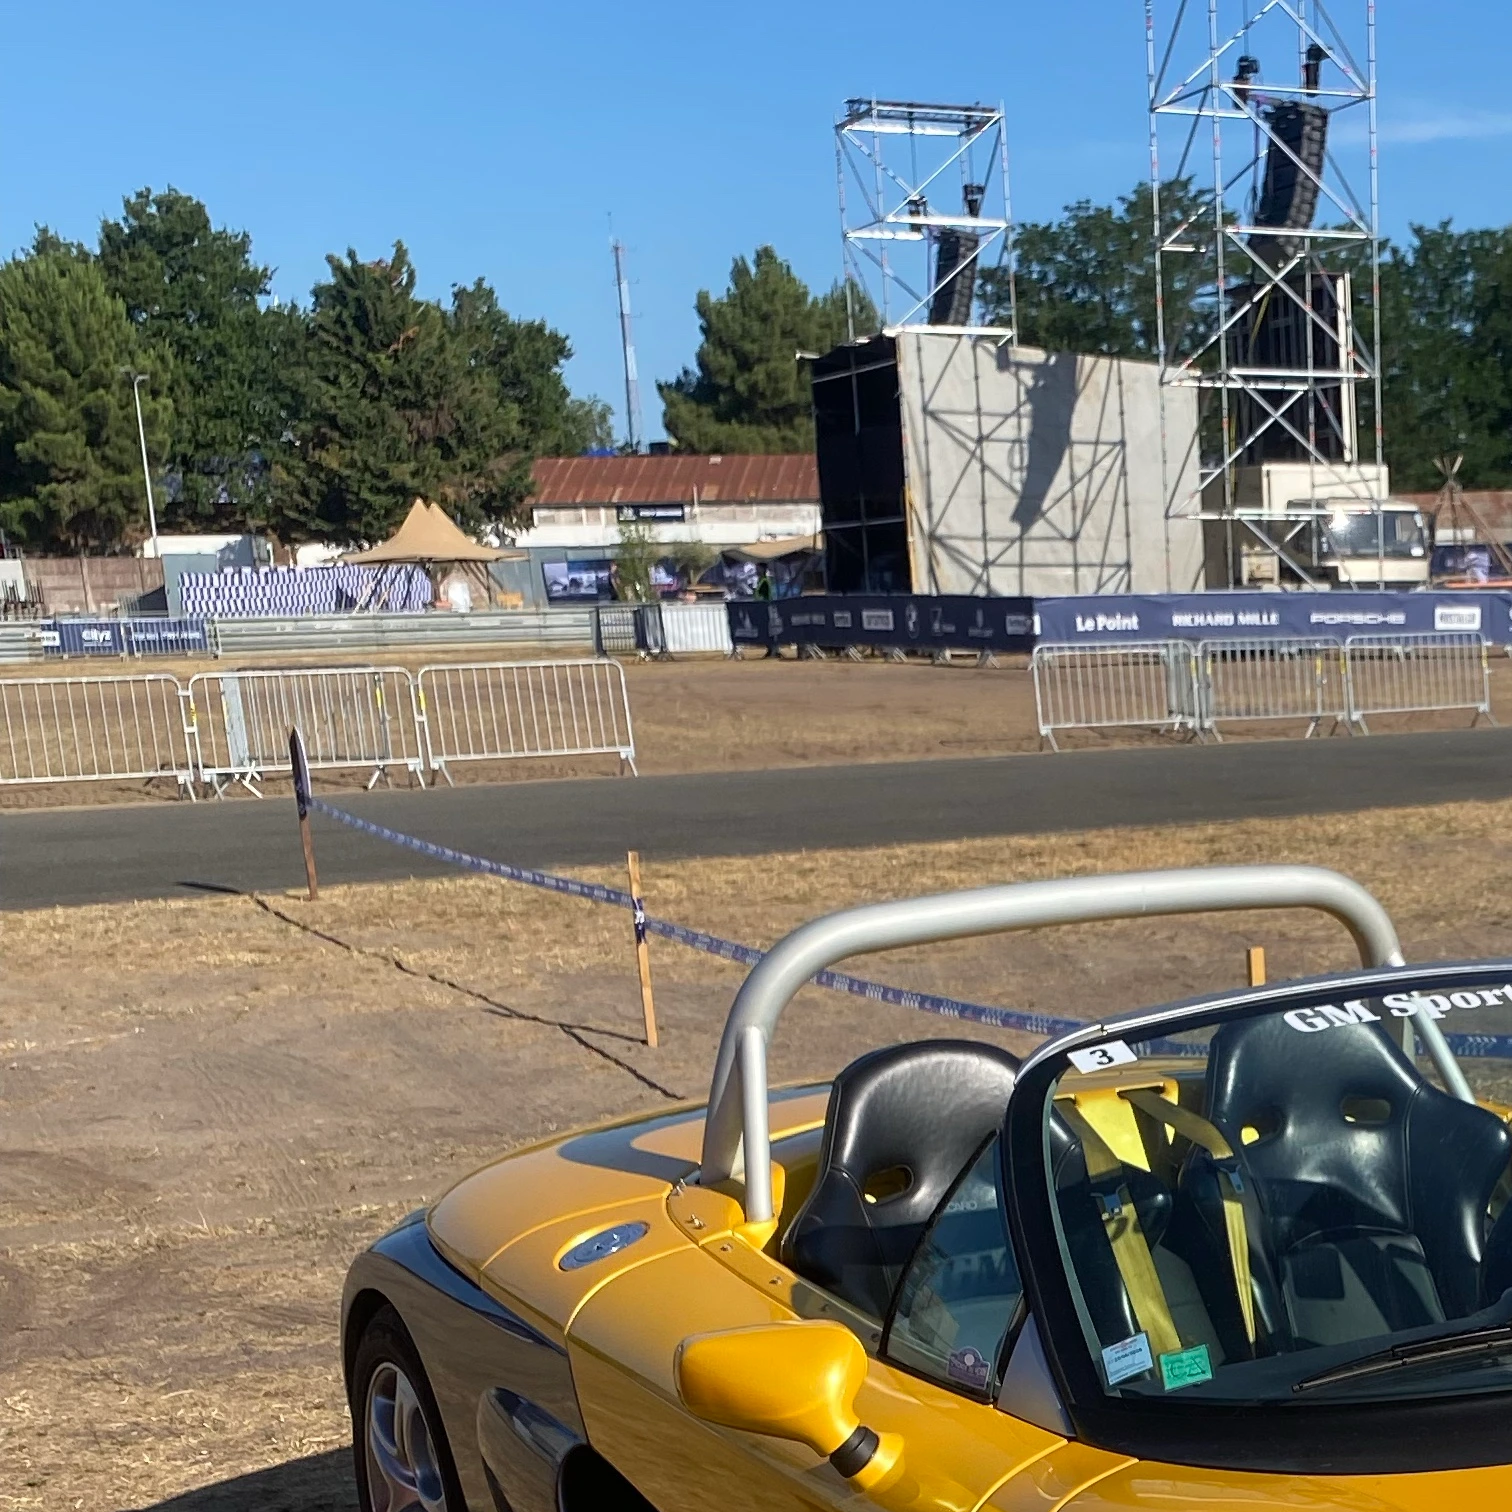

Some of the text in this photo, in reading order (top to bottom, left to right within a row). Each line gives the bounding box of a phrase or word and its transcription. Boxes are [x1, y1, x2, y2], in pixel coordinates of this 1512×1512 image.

[1076, 612, 1139, 632] Le Point
[1172, 611, 1279, 626] RICHARD MILLE
[1310, 613, 1406, 624] PORSCHE
[1283, 1000, 1381, 1033] GM
[1089, 1048, 1115, 1066] 3
